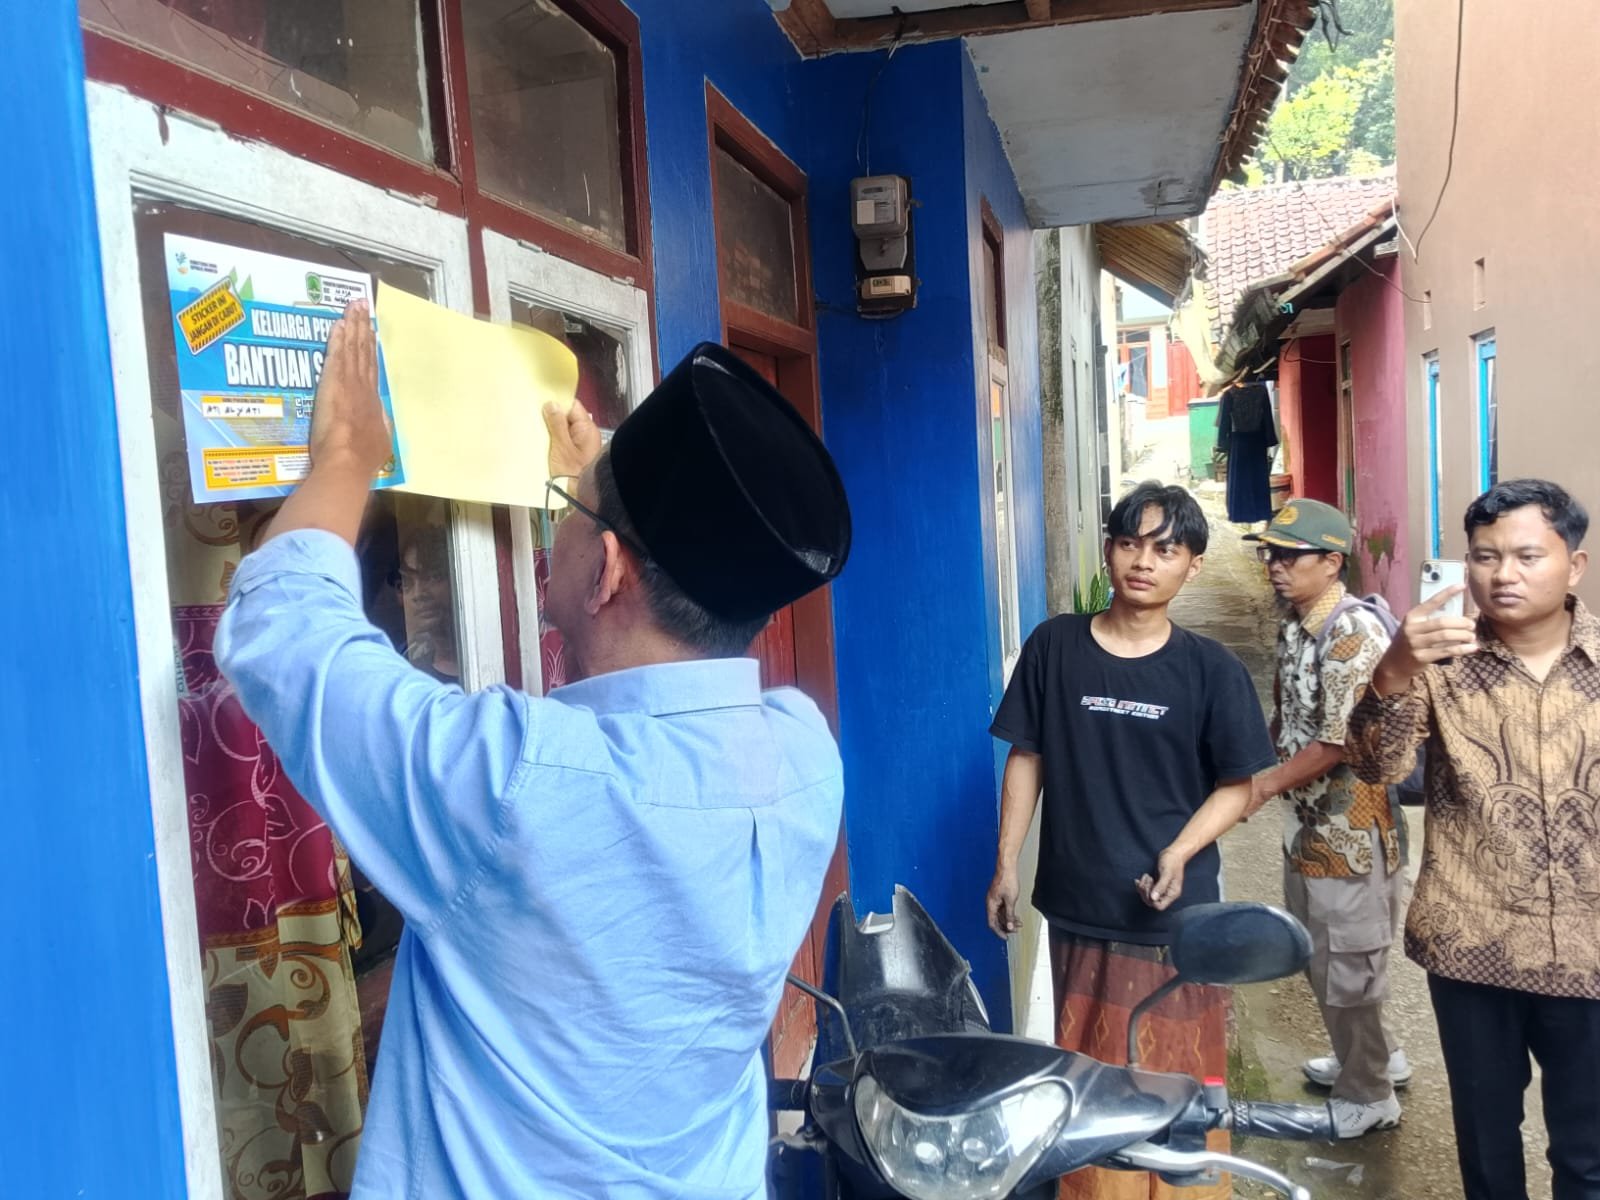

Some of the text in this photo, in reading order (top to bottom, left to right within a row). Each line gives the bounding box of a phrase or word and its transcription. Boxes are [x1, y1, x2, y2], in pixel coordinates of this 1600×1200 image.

[189, 302, 238, 342] JANGAN DI CABUT
[191, 294, 227, 325] STICKER INI
[250, 308, 313, 341] KELUARGA
[223, 343, 313, 389] BANTUAN
